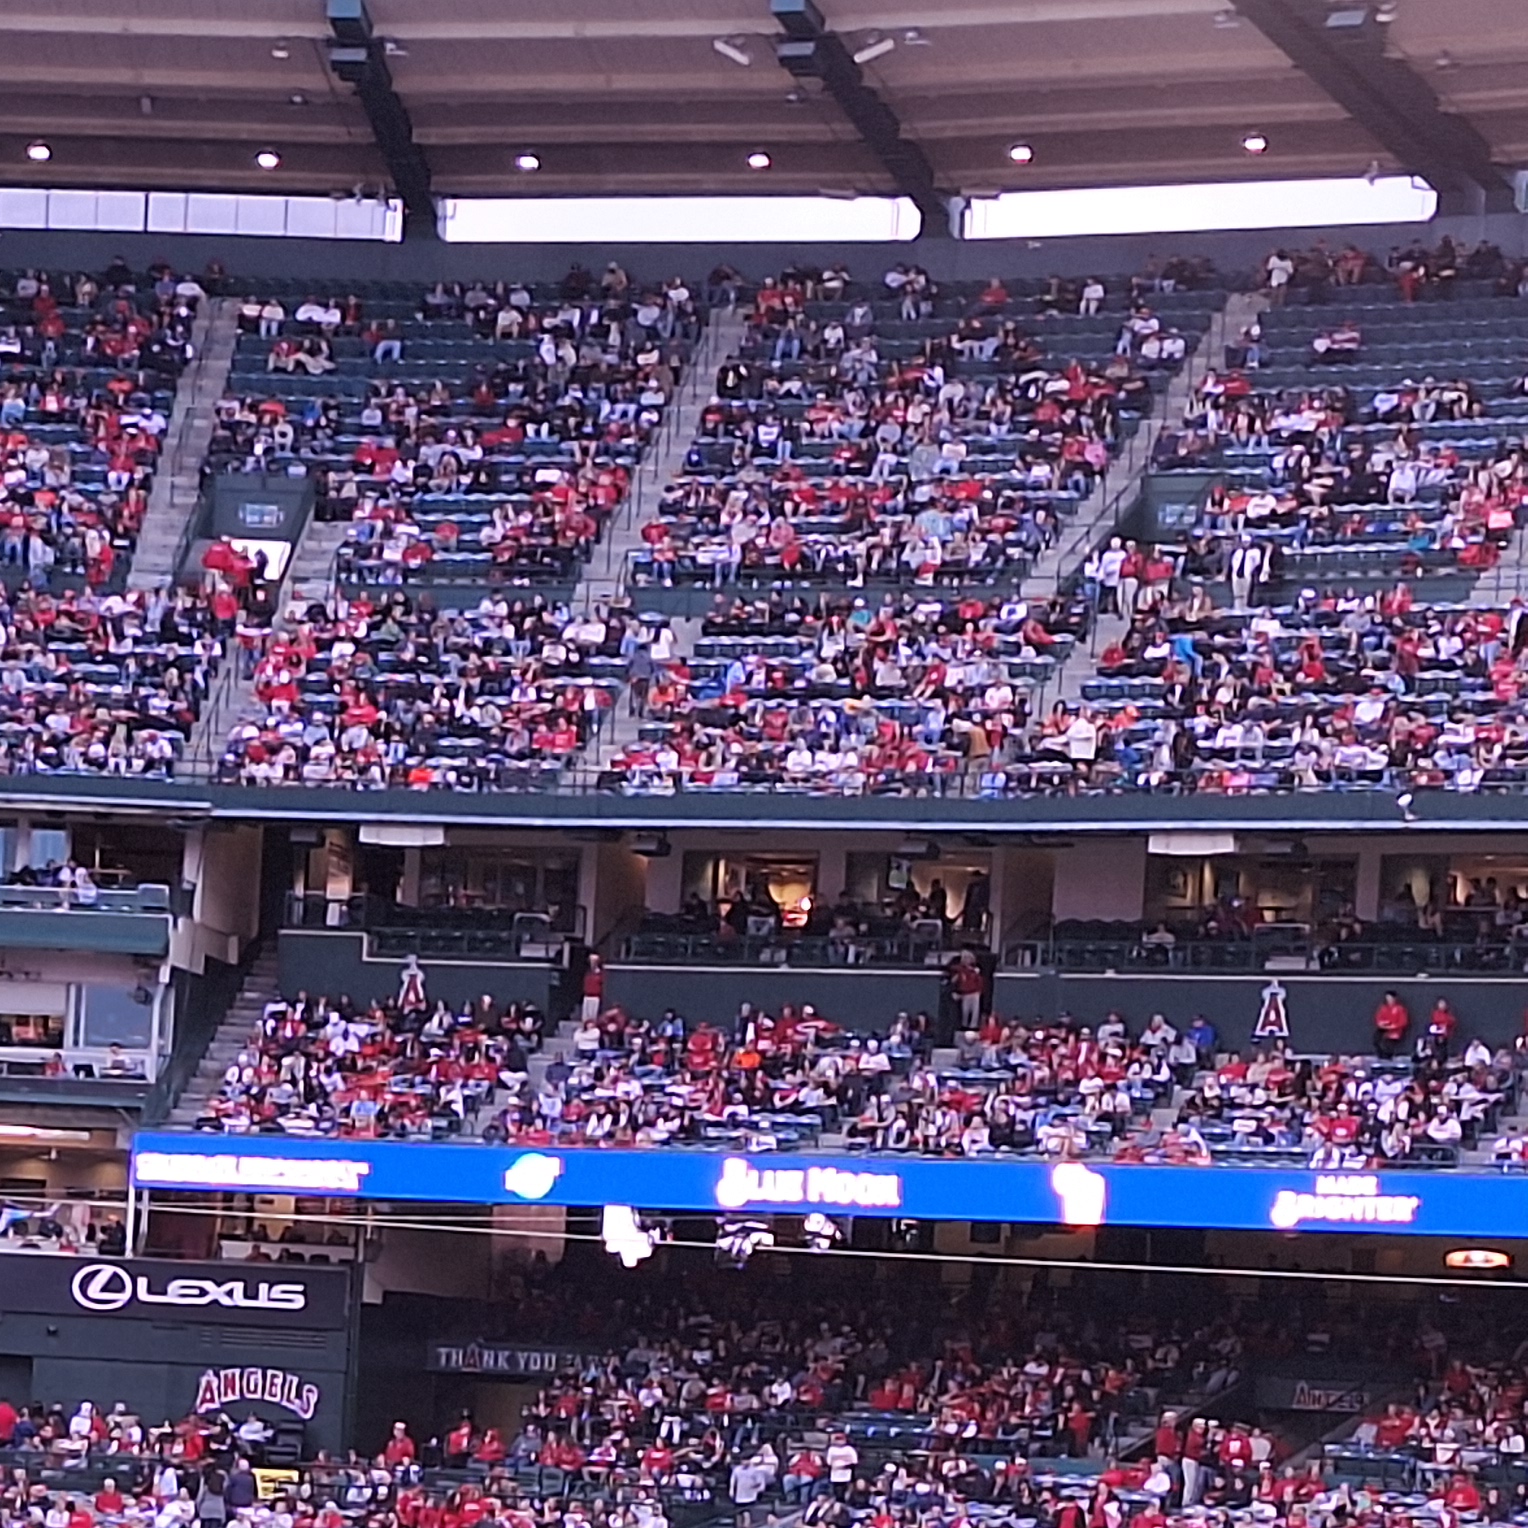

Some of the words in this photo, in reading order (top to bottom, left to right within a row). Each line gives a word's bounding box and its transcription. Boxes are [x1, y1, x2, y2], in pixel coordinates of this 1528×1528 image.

[1255, 981, 1289, 1037] A
[136, 1276, 306, 1310] LEXUS
[437, 1342, 510, 1372] THANK
[517, 1351, 557, 1372] YOU
[196, 1369, 319, 1419] ANGELS
